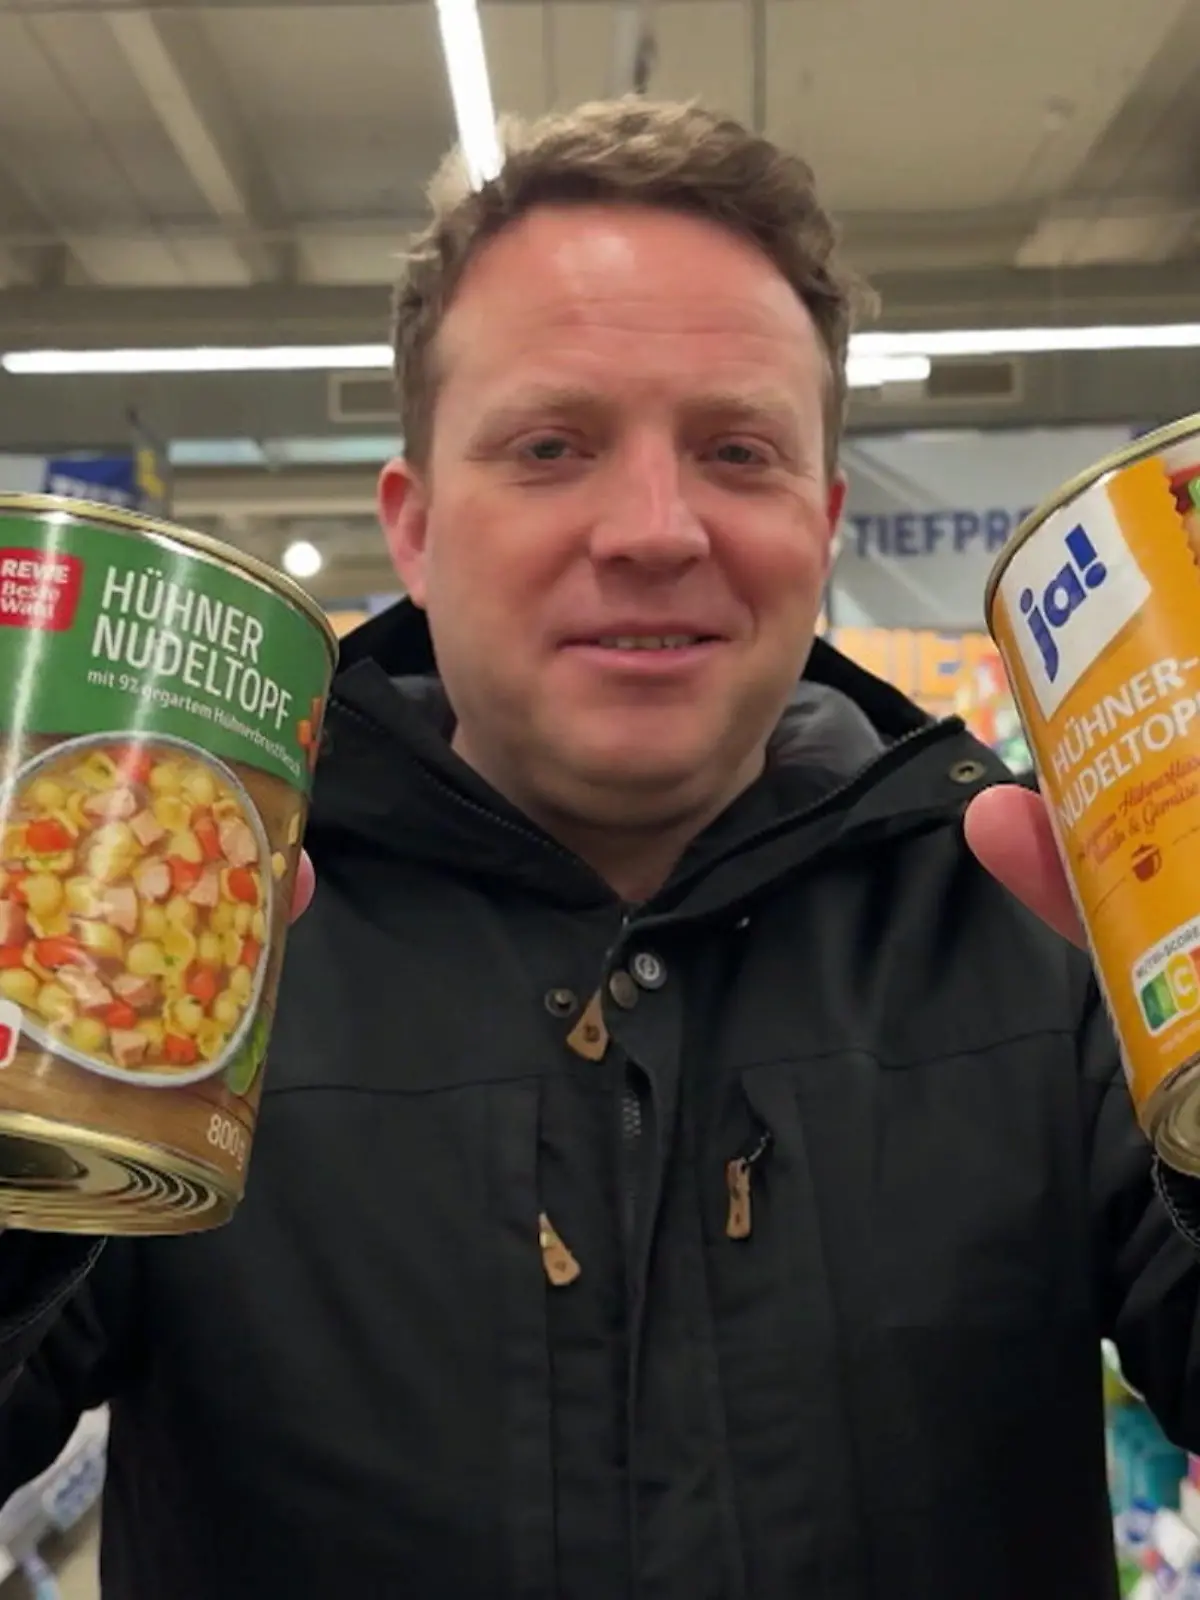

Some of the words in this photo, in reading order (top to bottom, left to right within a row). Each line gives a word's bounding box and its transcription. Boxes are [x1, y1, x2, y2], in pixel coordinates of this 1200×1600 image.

[1, 558, 71, 584] REWE
[2, 581, 61, 602] Beste
[1020, 523, 1107, 684] ja!
[102, 565, 264, 663] HÜHNER
[87, 669, 116, 688] mit
[92, 615, 293, 730] NUDELTOPF
[1052, 656, 1199, 785] HÜHNER-
[1173, 964, 1195, 996] C
